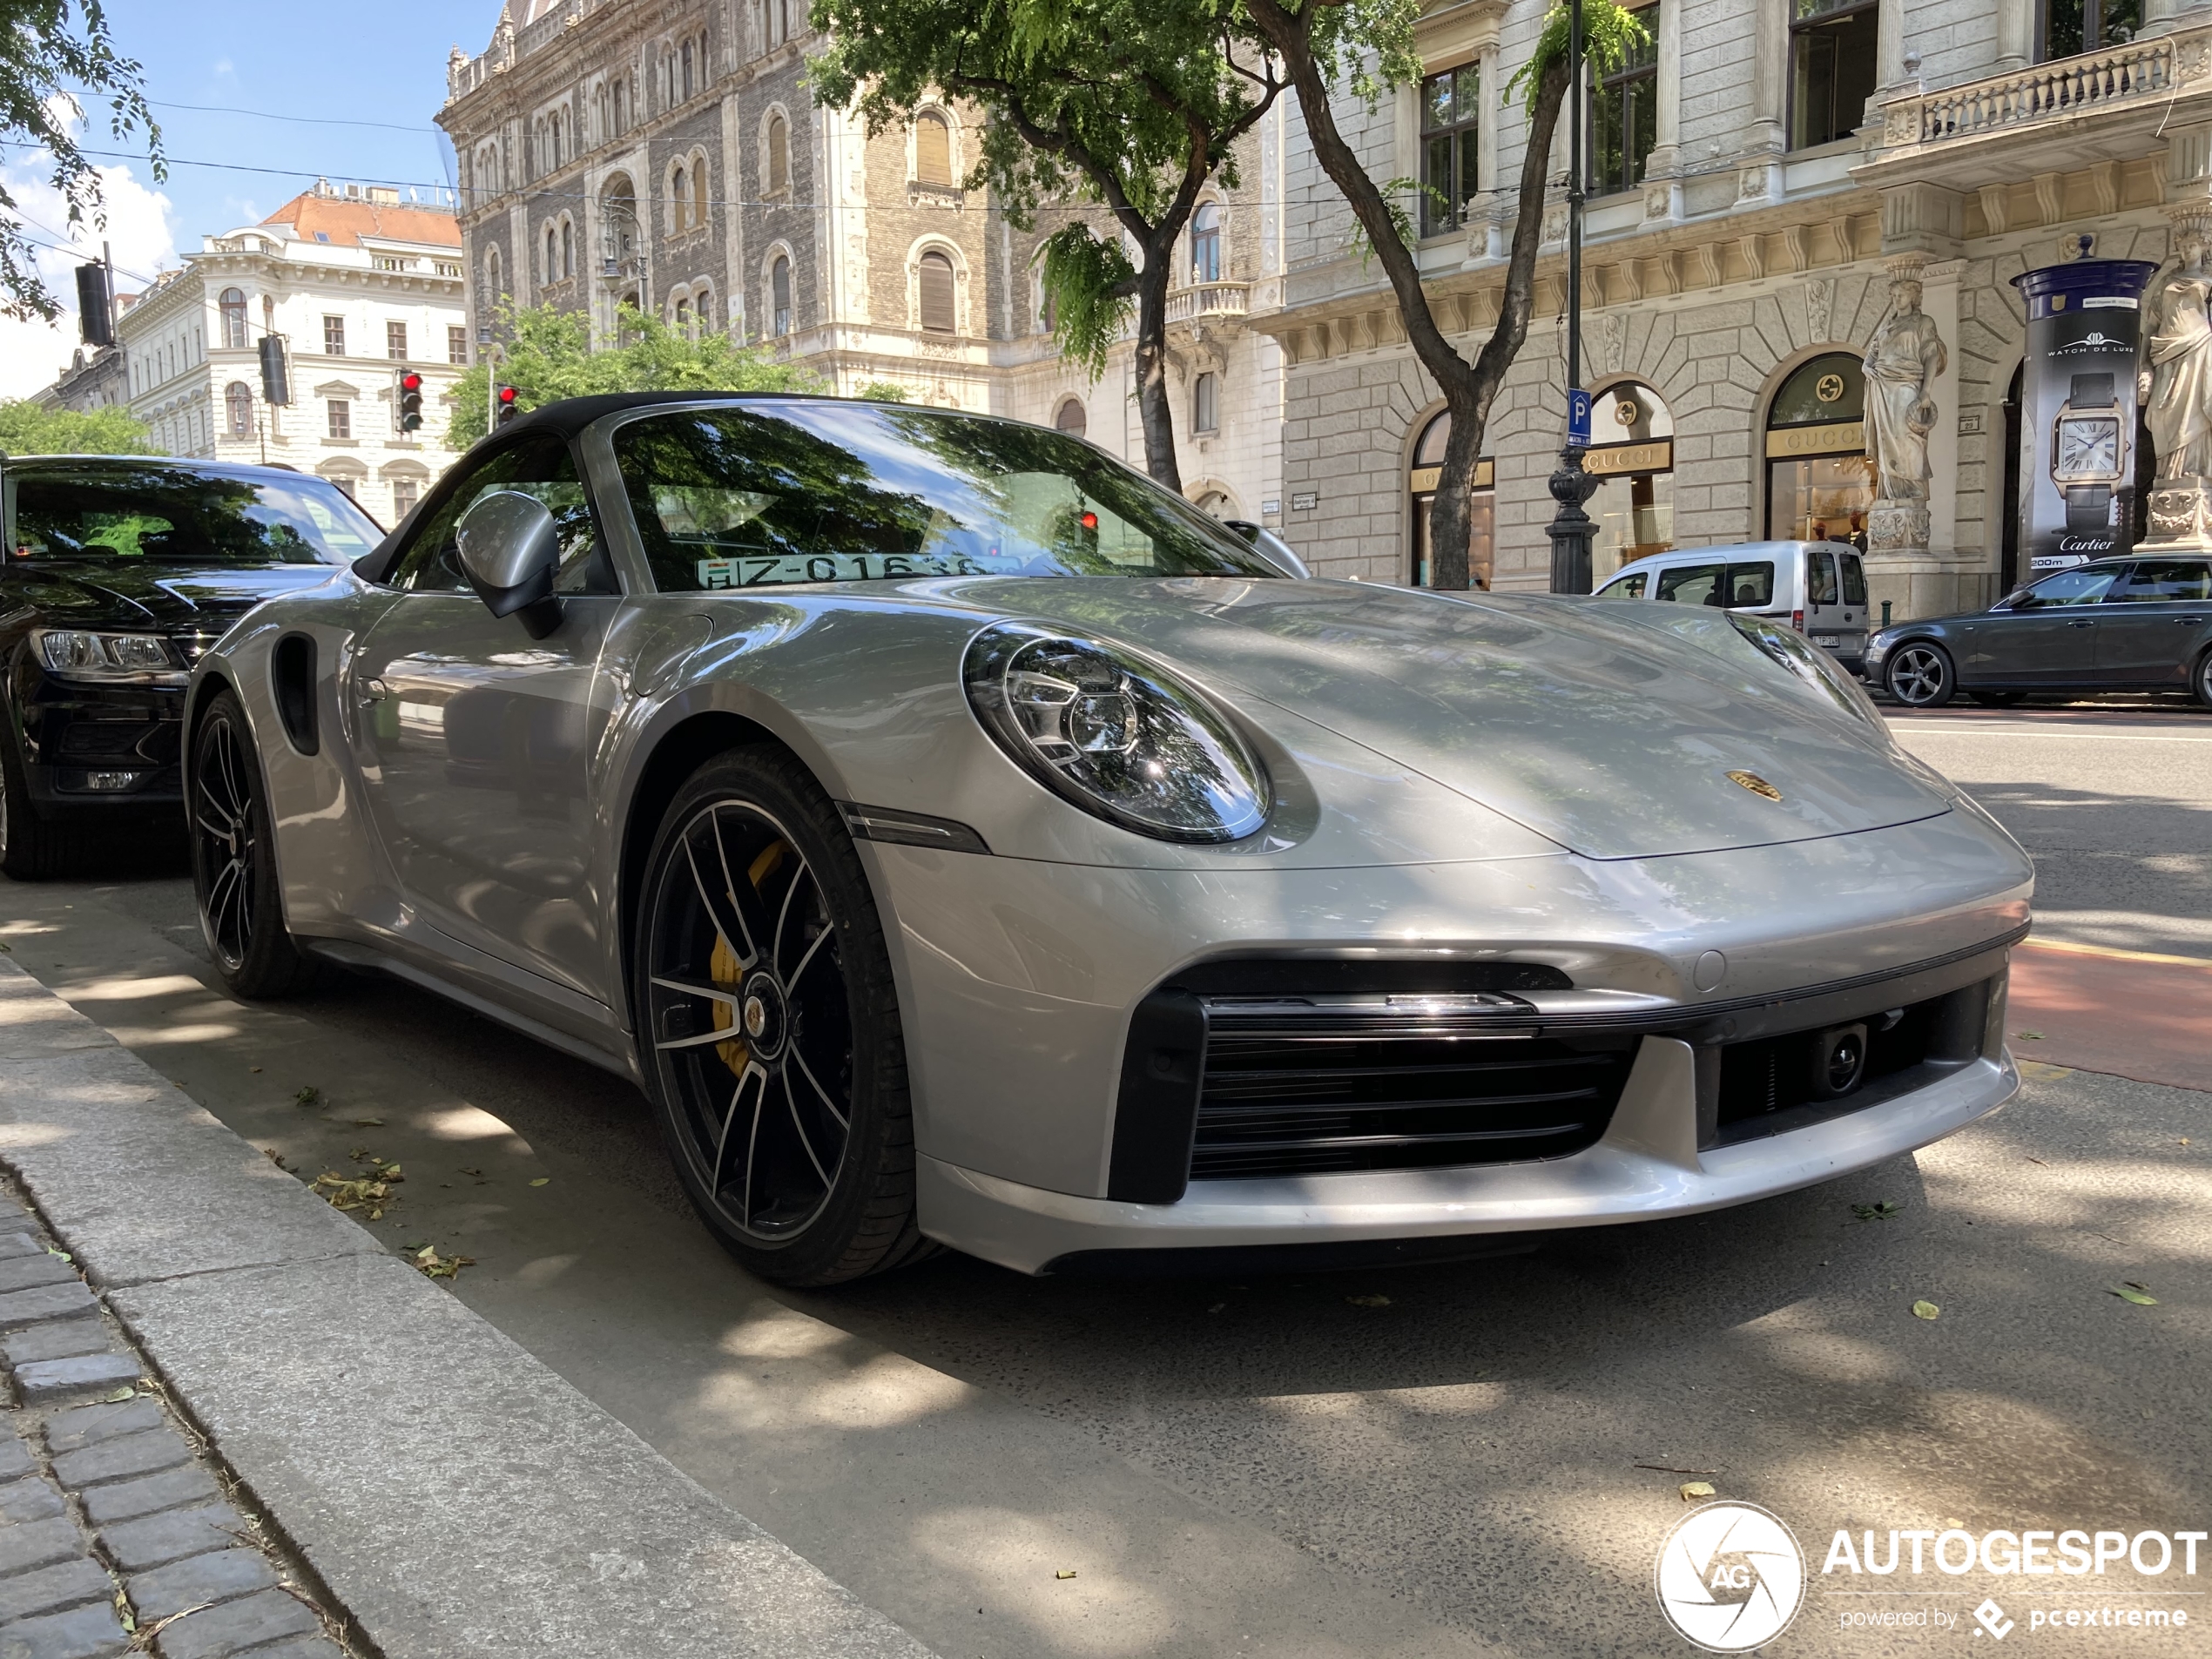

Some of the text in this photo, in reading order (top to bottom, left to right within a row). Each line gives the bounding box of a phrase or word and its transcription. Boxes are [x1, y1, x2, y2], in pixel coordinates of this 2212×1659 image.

[2047, 347, 2087, 357] WATCH
[1575, 401, 1586, 425] P
[1785, 428, 1865, 449] GUCCI
[1588, 449, 1653, 469] GUCCI
[2060, 535, 2114, 551] Cartier
